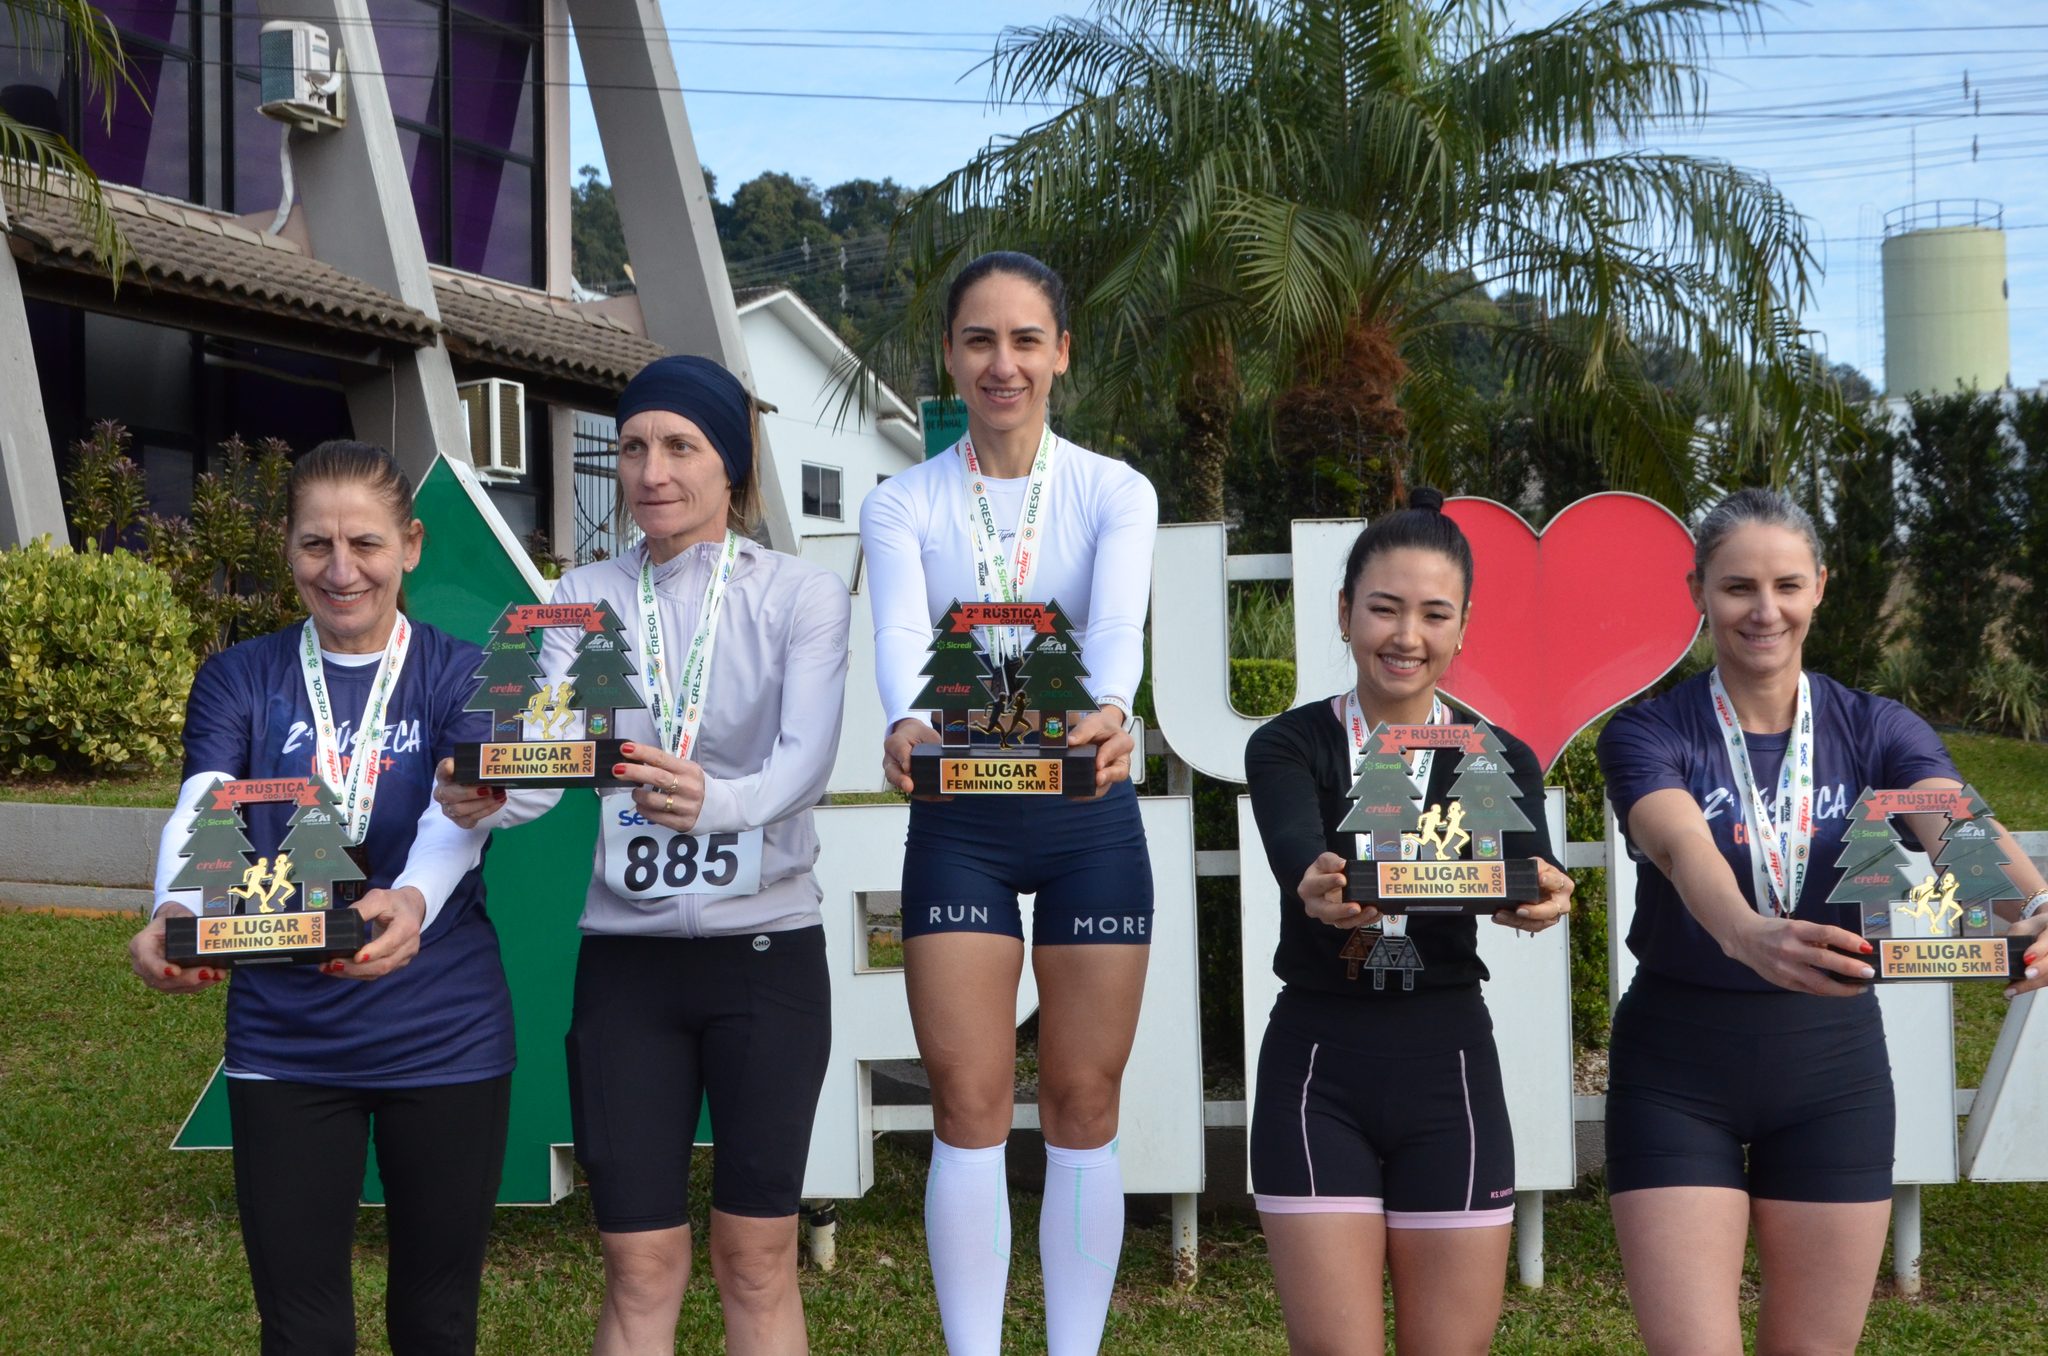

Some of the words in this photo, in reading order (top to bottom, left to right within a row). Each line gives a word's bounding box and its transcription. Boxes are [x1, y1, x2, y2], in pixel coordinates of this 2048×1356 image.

[965, 442, 978, 472] creluz
[1027, 481, 1042, 524] CRESOL
[978, 496, 996, 540] CRESOL
[1018, 550, 1028, 586] creluz
[536, 606, 592, 618] RÚSTICA
[983, 605, 1042, 618] RÚSTICA
[647, 610, 660, 654] CRESOL
[502, 642, 526, 650] Sicredi
[602, 640, 614, 648] A1
[683, 650, 698, 688] Sicredi
[490, 683, 524, 694] creluz
[936, 683, 972, 694] creluz
[312, 676, 329, 720] CRESOL
[1352, 718, 1362, 748] creluz
[1410, 726, 1470, 740] RÚSTICA
[512, 747, 572, 762] LUGAR
[582, 745, 592, 772] 2026
[326, 748, 338, 784] creluz
[366, 750, 378, 787] creluz
[486, 764, 548, 774] FEMININO
[552, 763, 579, 774] 5KM
[974, 764, 1037, 778] LUGAR
[1049, 763, 1059, 790] 2026
[245, 781, 305, 794] RÚSTICA
[946, 780, 1013, 790] FEMININO
[1018, 780, 1046, 790] 5KM
[1898, 792, 1958, 806] RÚSTICA
[1365, 804, 1402, 814] creluz
[1800, 796, 1810, 834] creluz
[208, 818, 234, 826] Sicredi
[319, 814, 330, 822] A1
[1862, 829, 1888, 838] Sicredi
[196, 858, 233, 870] creluz
[624, 834, 738, 892] 885
[1414, 866, 1480, 881] LUGAR
[1492, 866, 1501, 894] 2026
[1854, 873, 1890, 884] creluz
[1386, 884, 1454, 894] FEMININO
[1459, 884, 1488, 894] 5KM
[929, 904, 988, 924] RUN
[233, 918, 299, 935] LUGAR
[312, 916, 322, 944] 2026
[1074, 916, 1146, 936] MORE
[204, 936, 274, 950] FEMININO
[278, 934, 308, 945] 5KM
[1916, 944, 1982, 960] LUGAR
[1994, 944, 2004, 972] 2026
[1888, 962, 1957, 974] FEMININO
[1962, 962, 1992, 972] 5KM
